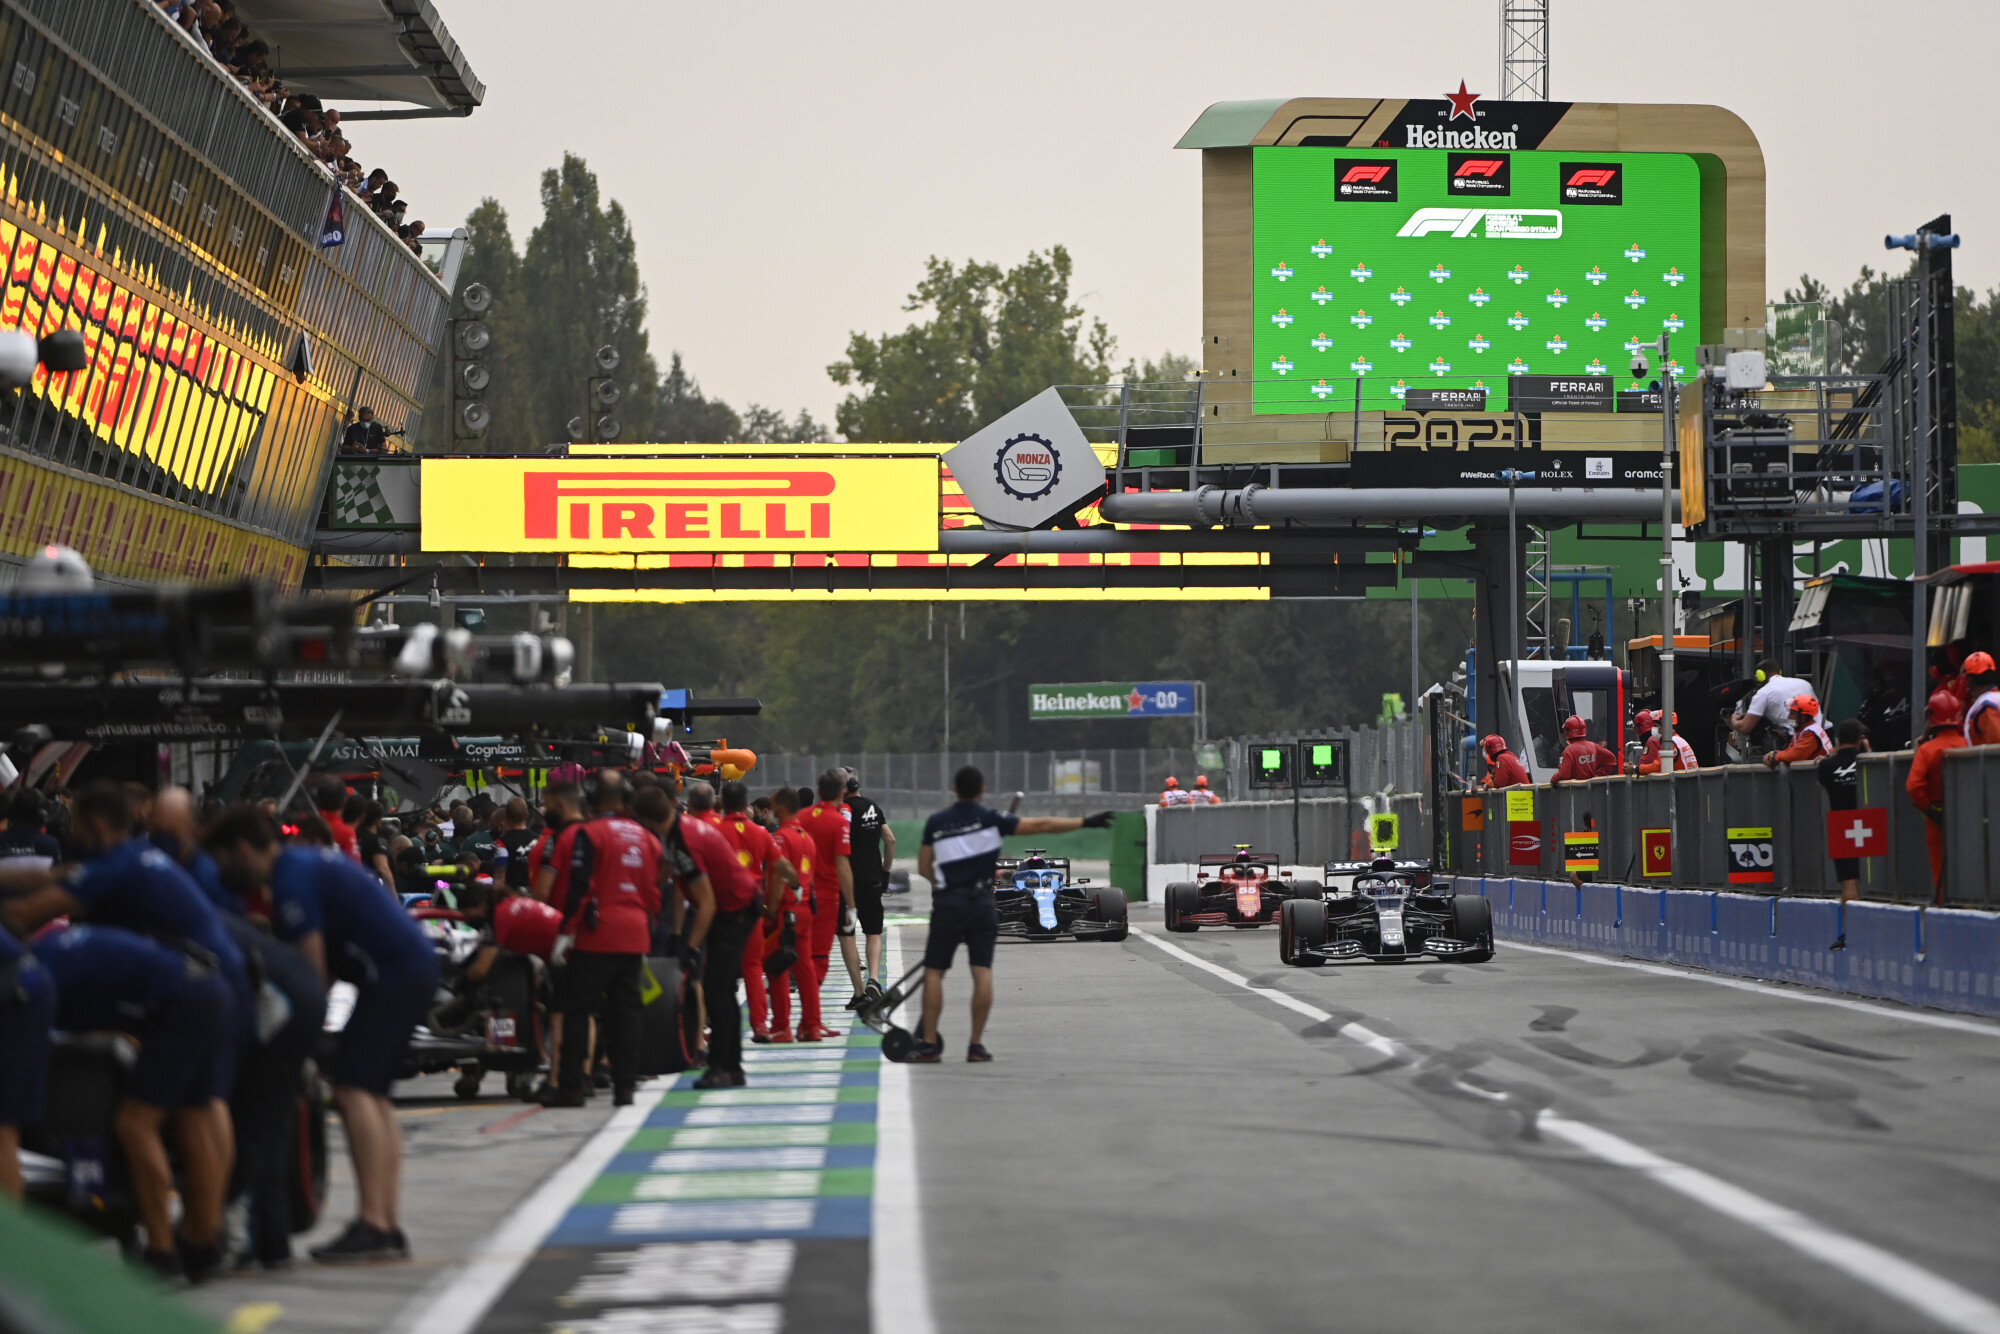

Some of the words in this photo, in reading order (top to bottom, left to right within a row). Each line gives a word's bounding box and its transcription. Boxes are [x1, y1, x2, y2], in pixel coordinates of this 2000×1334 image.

[1405, 123, 1518, 150] Heineken
[1550, 381, 1604, 393] FERRARI
[1431, 392, 1481, 402] FERRARI
[1016, 453, 1051, 465] MONZA
[1540, 470, 1574, 479] ROLEX
[523, 471, 836, 539] PIRELLI
[1032, 692, 1123, 712] Heineken
[1578, 754, 1597, 765] CEA
[1333, 860, 1421, 870] HODA
